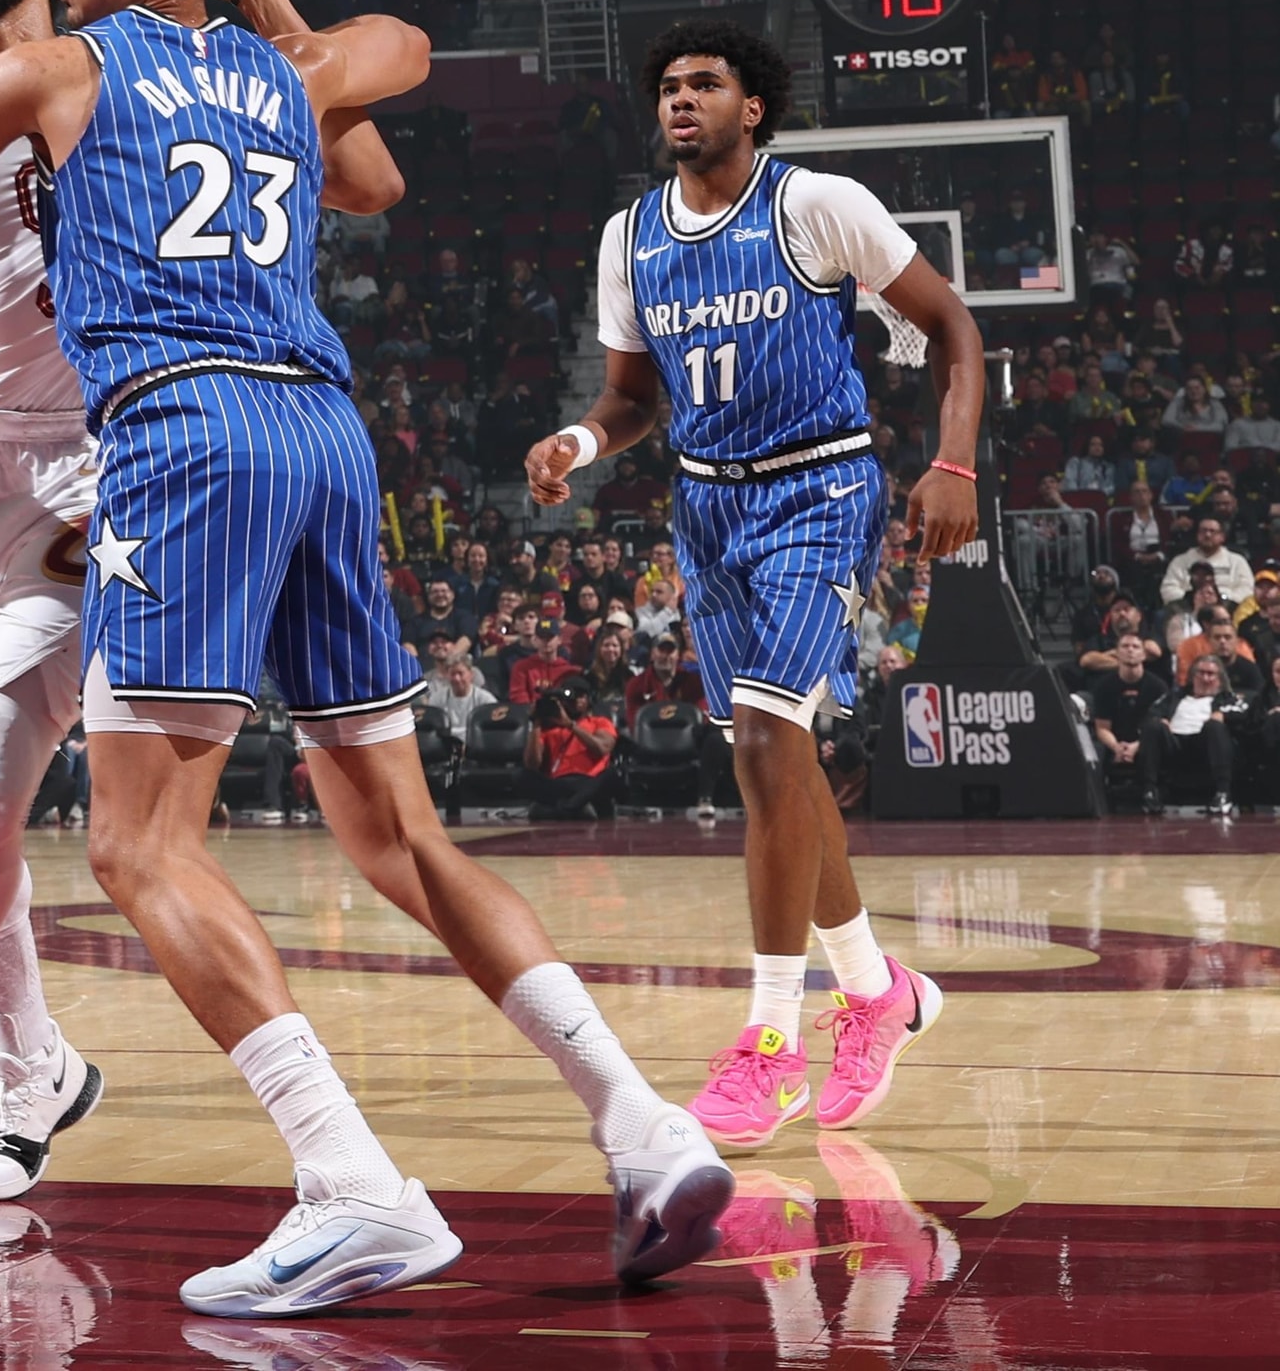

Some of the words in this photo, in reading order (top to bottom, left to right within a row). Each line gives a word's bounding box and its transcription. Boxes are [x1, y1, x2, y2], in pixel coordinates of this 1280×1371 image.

[870, 47, 967, 70] TISSOT
[133, 66, 196, 119] DA
[193, 66, 284, 132] SILVA
[157, 139, 299, 268] 23
[685, 341, 737, 406] 11
[955, 539, 989, 568] App
[945, 684, 1036, 732] League
[948, 725, 1011, 765] Pass
